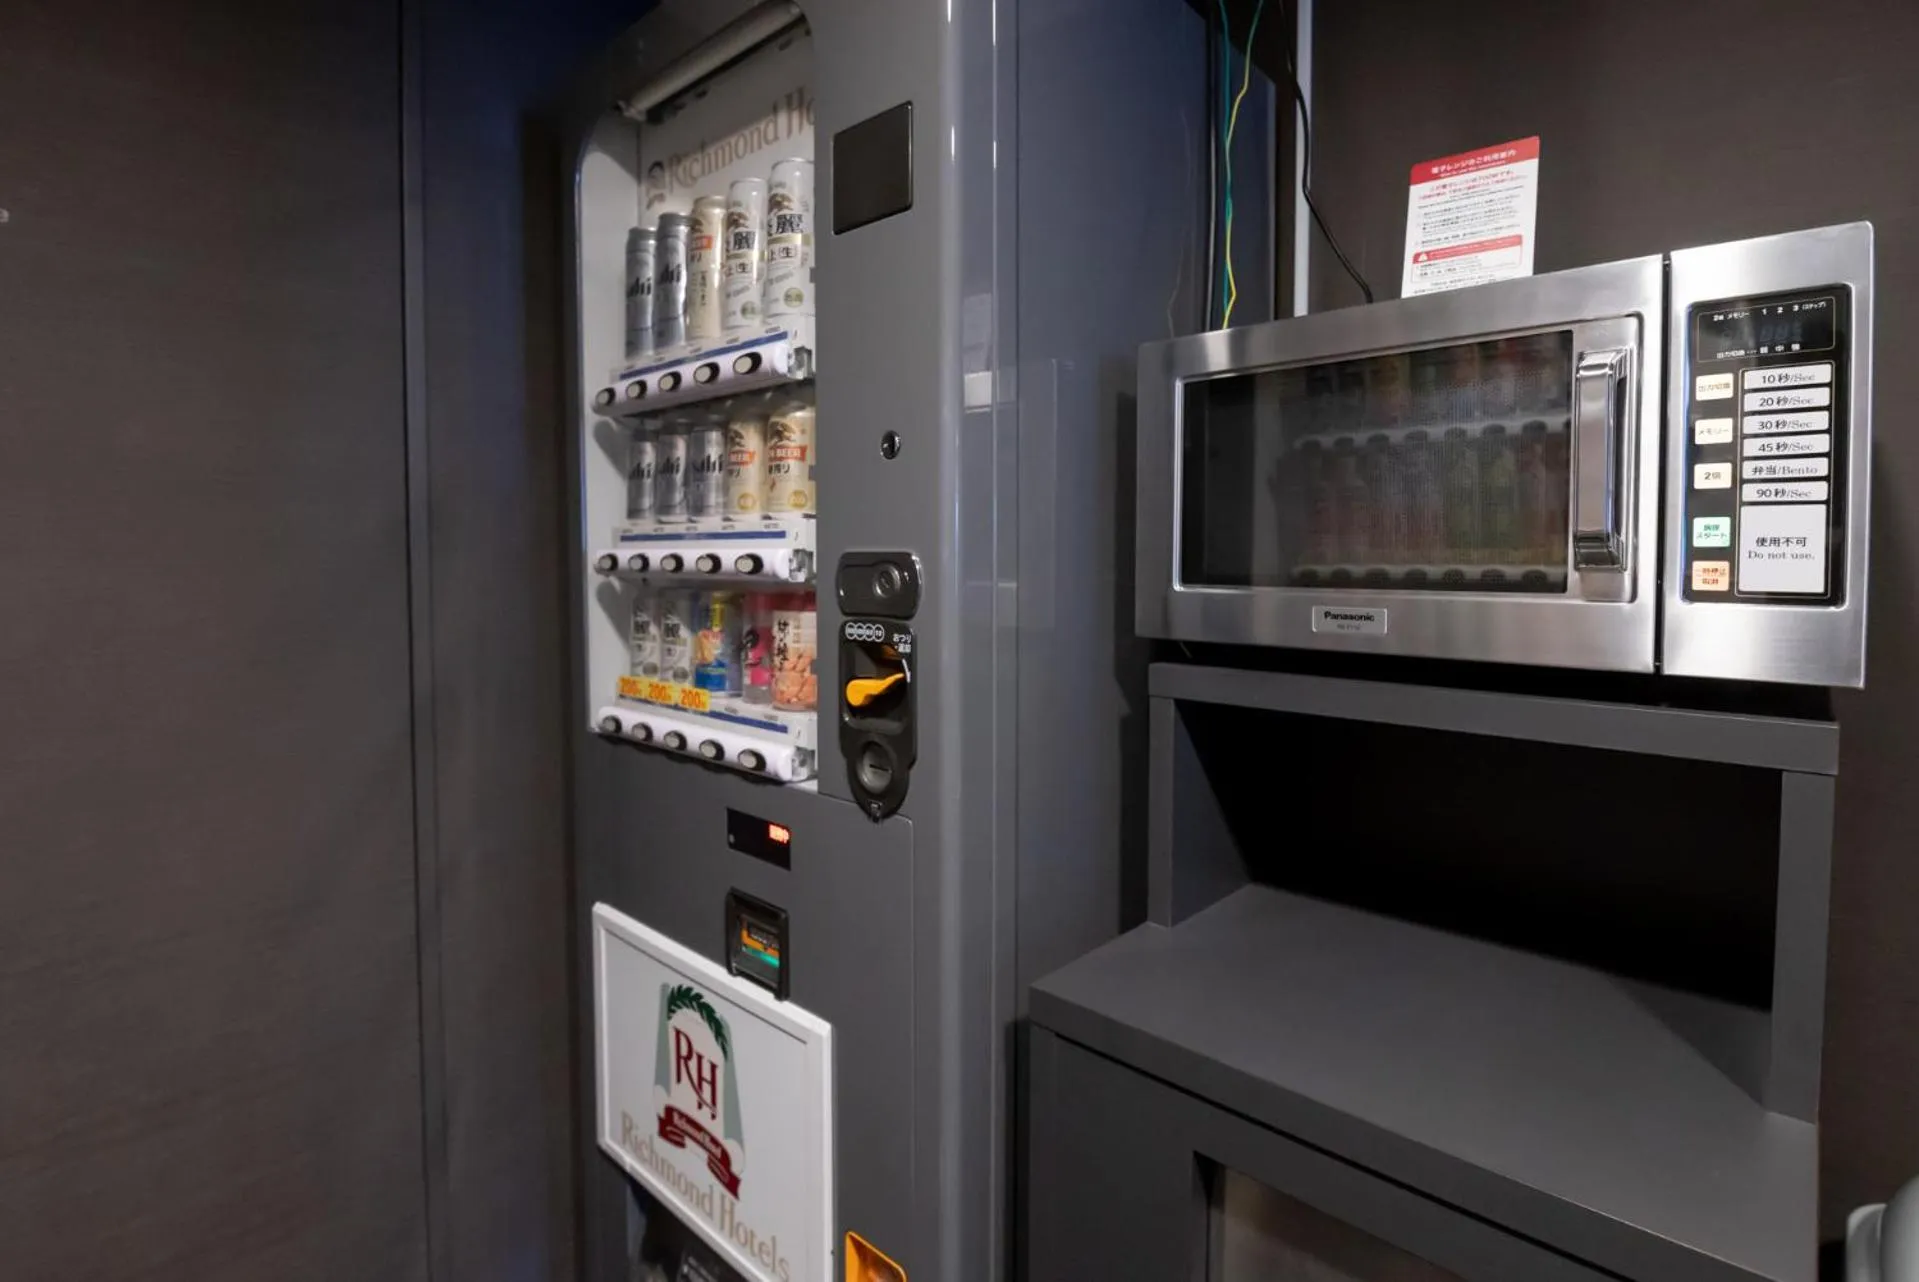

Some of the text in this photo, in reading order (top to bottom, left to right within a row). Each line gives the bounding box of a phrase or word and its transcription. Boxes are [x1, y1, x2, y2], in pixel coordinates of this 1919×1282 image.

[668, 101, 780, 194] Richmond
[1793, 304, 1800, 312] 3
[1755, 536, 1808, 548] 使用不可
[1748, 551, 1816, 561] Do not use.
[1323, 611, 1375, 622] Panasonic
[648, 682, 673, 702] 200
[681, 687, 709, 709] 200
[621, 1111, 714, 1221] Richmond
[718, 1194, 790, 1282] Hotels
